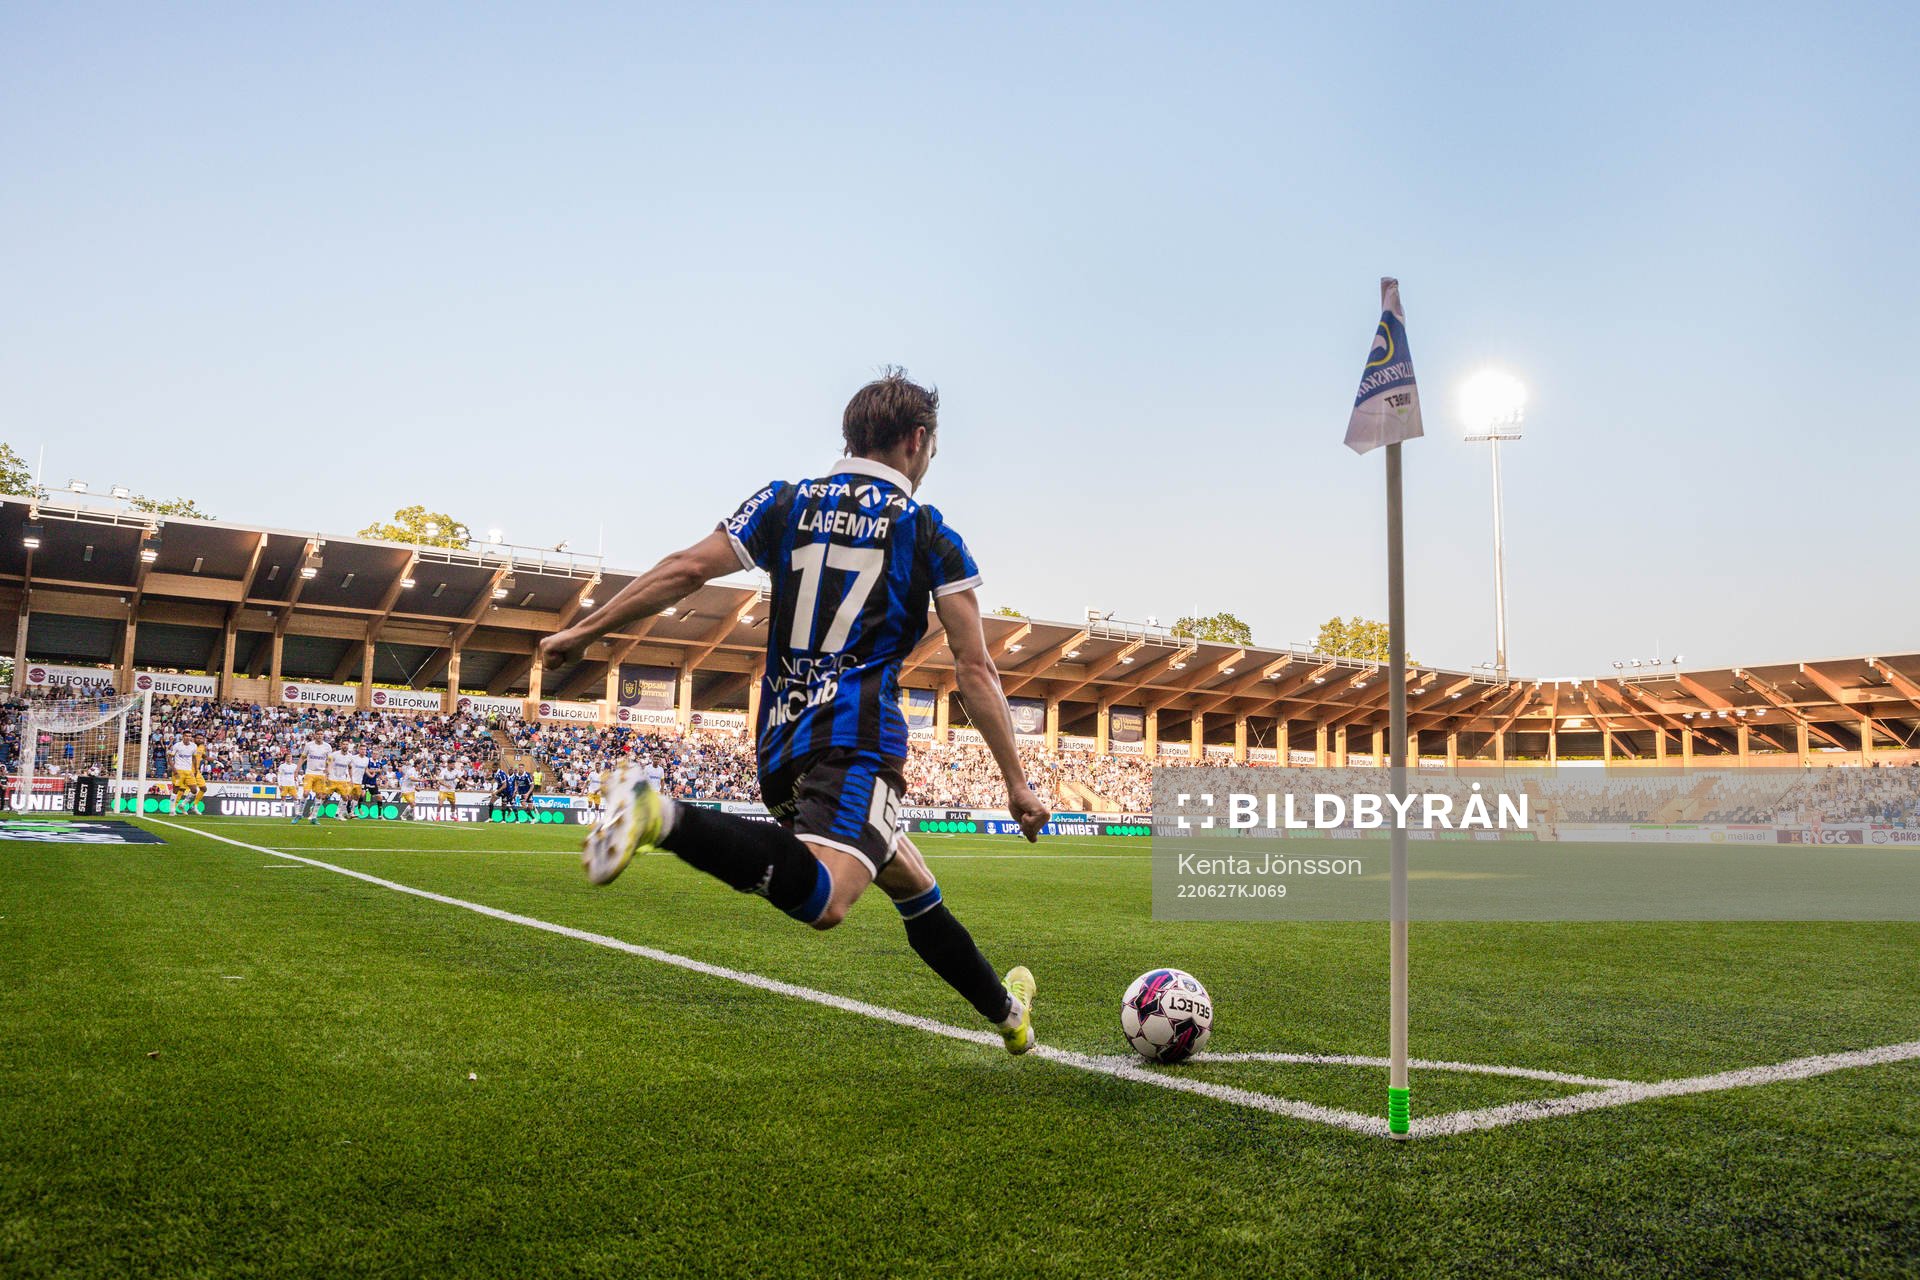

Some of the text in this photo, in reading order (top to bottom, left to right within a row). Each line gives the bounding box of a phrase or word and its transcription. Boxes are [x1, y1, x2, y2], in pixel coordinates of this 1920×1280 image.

[797, 508, 890, 538] LAGEMYR
[790, 543, 885, 652] 17
[48, 675, 111, 688] BILFORUM
[154, 682, 213, 695] BILFORUM
[301, 691, 354, 703] BILFORUM
[388, 697, 439, 709] BILFORUM
[473, 703, 521, 714] BILFORUM
[552, 708, 598, 719] BILFORUM
[631, 713, 675, 724] BILFORUM
[703, 719, 745, 729] BILFORUM
[908, 732, 934, 740] FORUM
[956, 735, 984, 743] BILFORU
[1016, 739, 1044, 747] ILFORUM
[1063, 742, 1094, 750] BILFORUM
[1114, 744, 1143, 753] BILFORUM
[10, 793, 64, 811] UNIB
[79, 783, 89, 813] SELECT
[96, 784, 104, 813] SELECT
[220, 800, 295, 817] UNIBET
[413, 806, 480, 822] UNIBET
[1057, 823, 1100, 836] UNIBET
[1157, 826, 1193, 837] UNIBET
[1250, 828, 1283, 838] UNIBET
[1407, 830, 1436, 840] UNIBET
[1169, 996, 1210, 1019] SELECT
